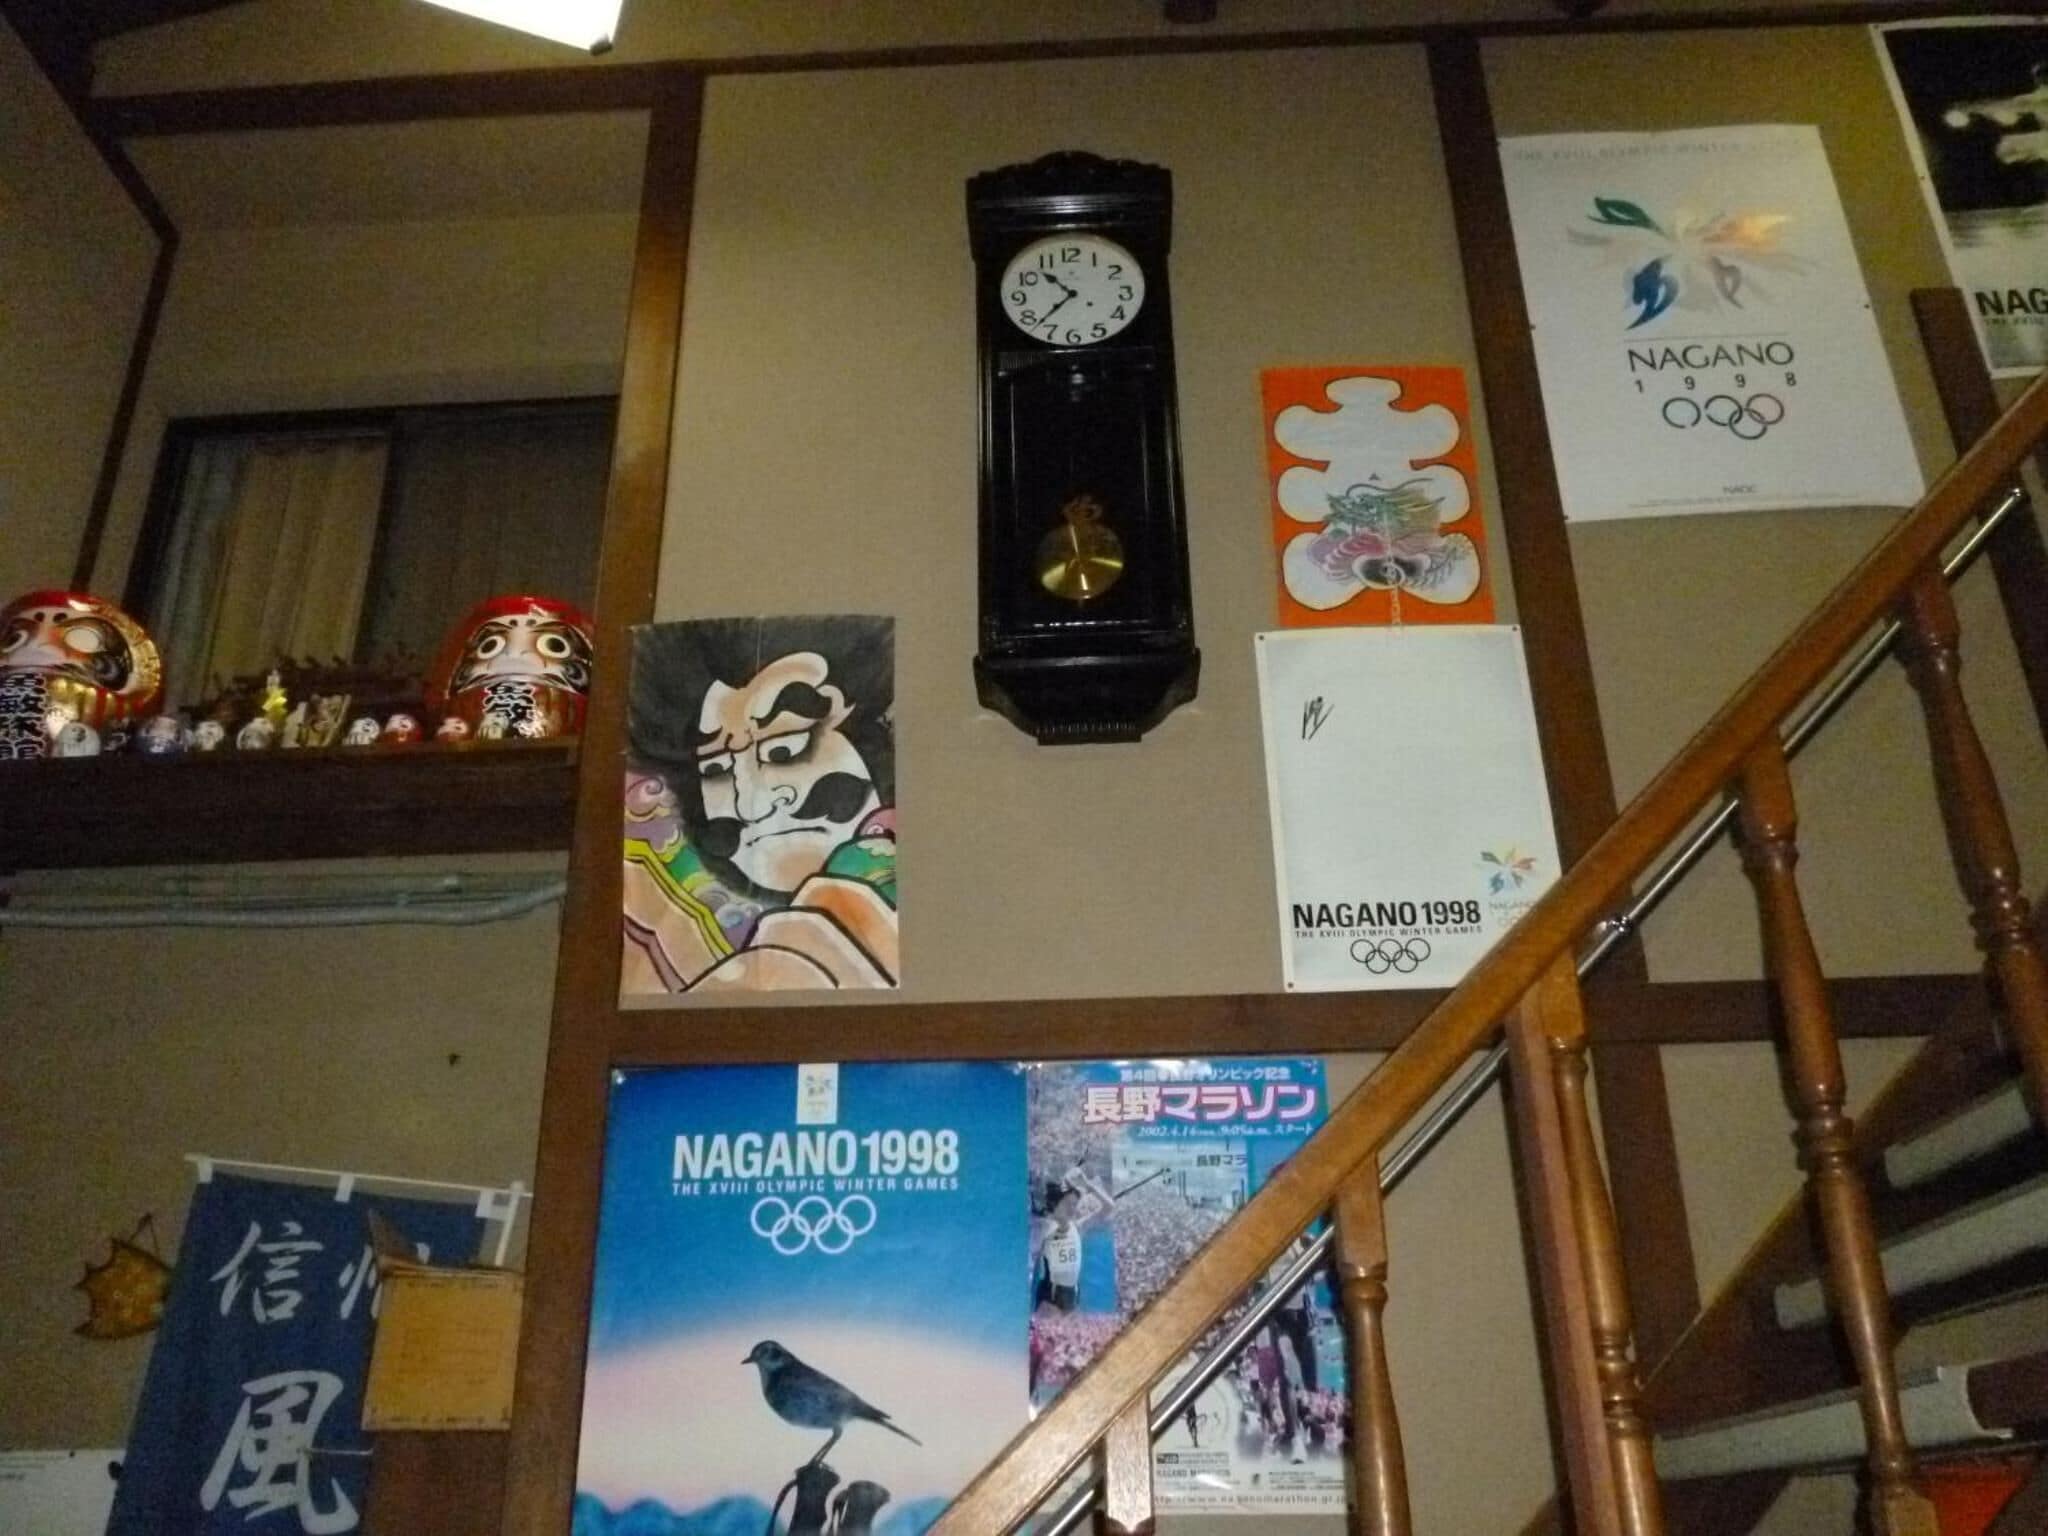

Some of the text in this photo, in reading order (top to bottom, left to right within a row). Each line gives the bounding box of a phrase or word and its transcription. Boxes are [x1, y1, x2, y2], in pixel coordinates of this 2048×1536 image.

[1039, 253, 1054, 269] 11
[1061, 247, 1081, 263] 12
[1019, 270, 1039, 286] 10
[1107, 264, 1123, 281] 2
[1010, 290, 1027, 306] 9
[1118, 285, 1134, 301] 3
[1019, 310, 1037, 326] 8
[1110, 305, 1126, 321] 4
[1043, 324, 1058, 340] 7
[1066, 328, 1081, 344] 6
[1090, 323, 1107, 339] 5
[1627, 340, 1795, 373] NAGANO
[1292, 900, 1481, 928] NAGANO 1998
[1295, 930, 1314, 939] THE
[1349, 927, 1396, 938] OLYMPIC
[1400, 926, 1442, 936] WINTER
[1445, 924, 1483, 935] GAMES
[1083, 1085, 1316, 1124] 長野マラソン
[673, 1129, 960, 1180] NAGANO 1998
[673, 1176, 959, 1196] THE XVIII OLYMPIC WINTER GAMES
